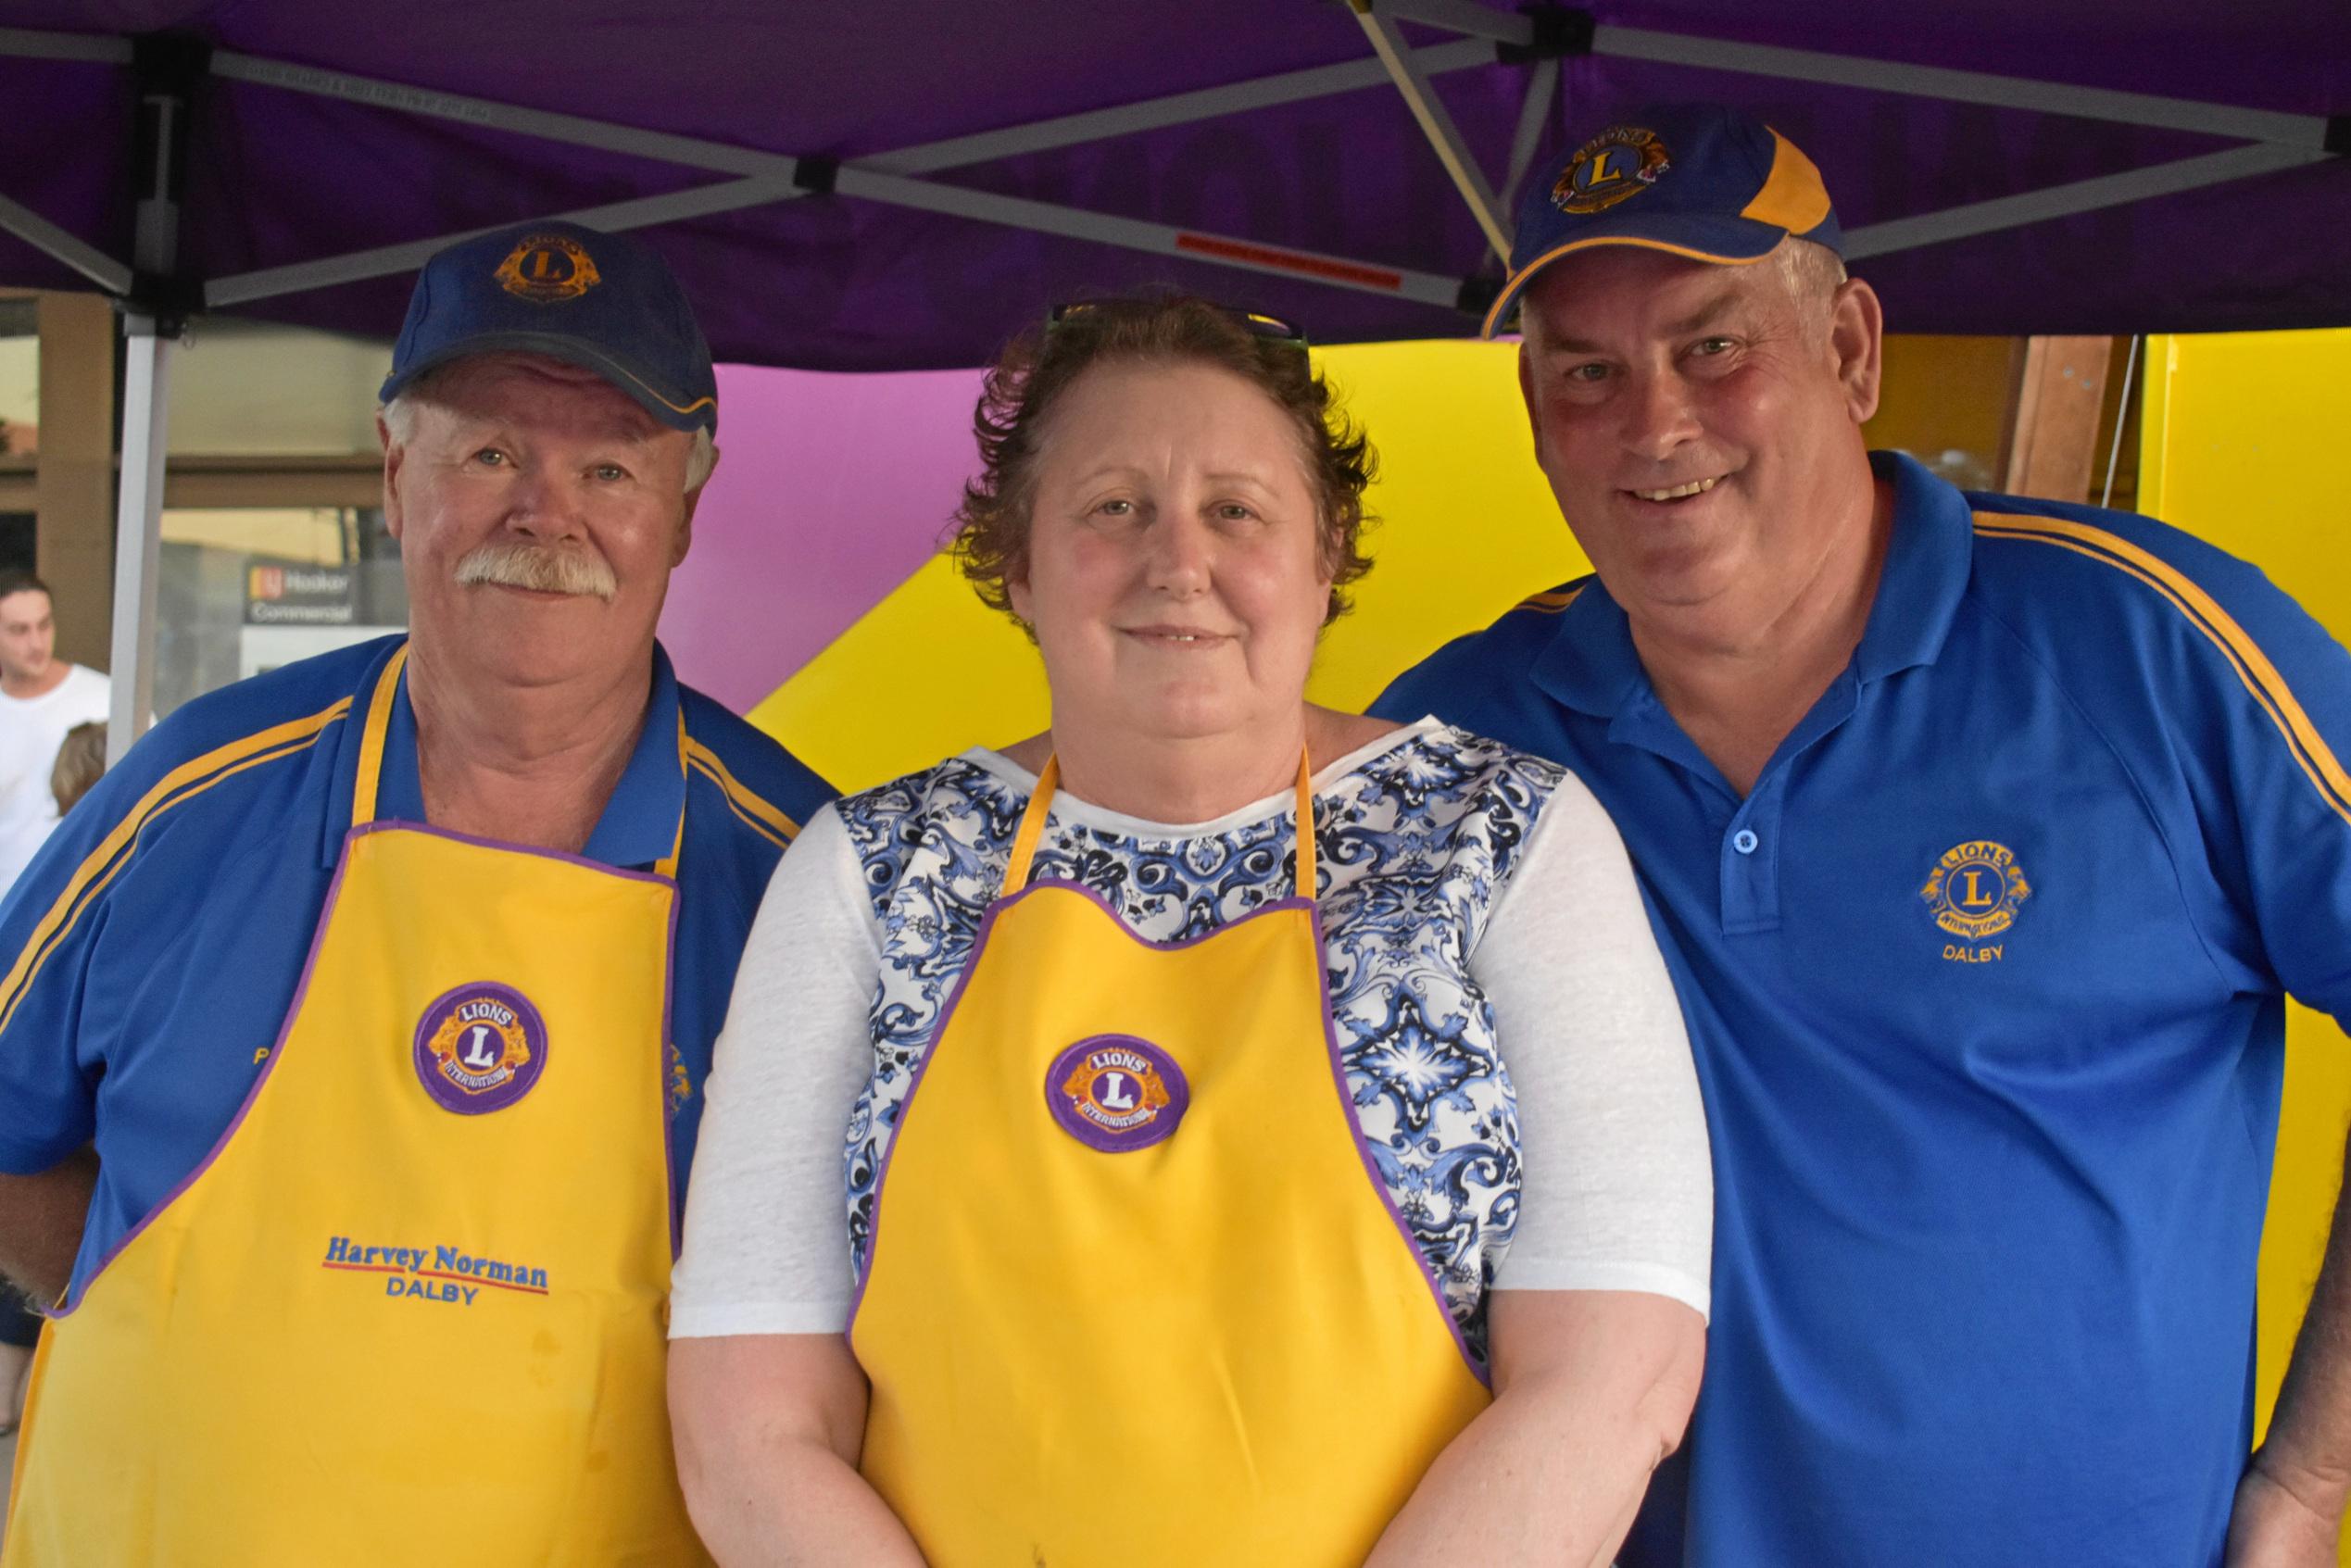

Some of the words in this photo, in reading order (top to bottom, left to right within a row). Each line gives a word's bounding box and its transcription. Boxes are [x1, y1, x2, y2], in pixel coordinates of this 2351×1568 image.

[1589, 151, 1622, 185] L
[534, 251, 561, 280] L
[286, 570, 348, 593] Hooker
[251, 602, 352, 622] Commercial
[1945, 844, 2010, 866] LIONS
[1962, 872, 1992, 906] L
[1942, 944, 2003, 963] DALBY
[461, 1003, 512, 1025] LIONS
[464, 1025, 494, 1067] L
[1092, 1052, 1147, 1072] LIONS
[1101, 1072, 1134, 1110] L
[325, 1236, 428, 1272] Harvey
[434, 1245, 548, 1288] Norman
[385, 1276, 479, 1306] DALBY
